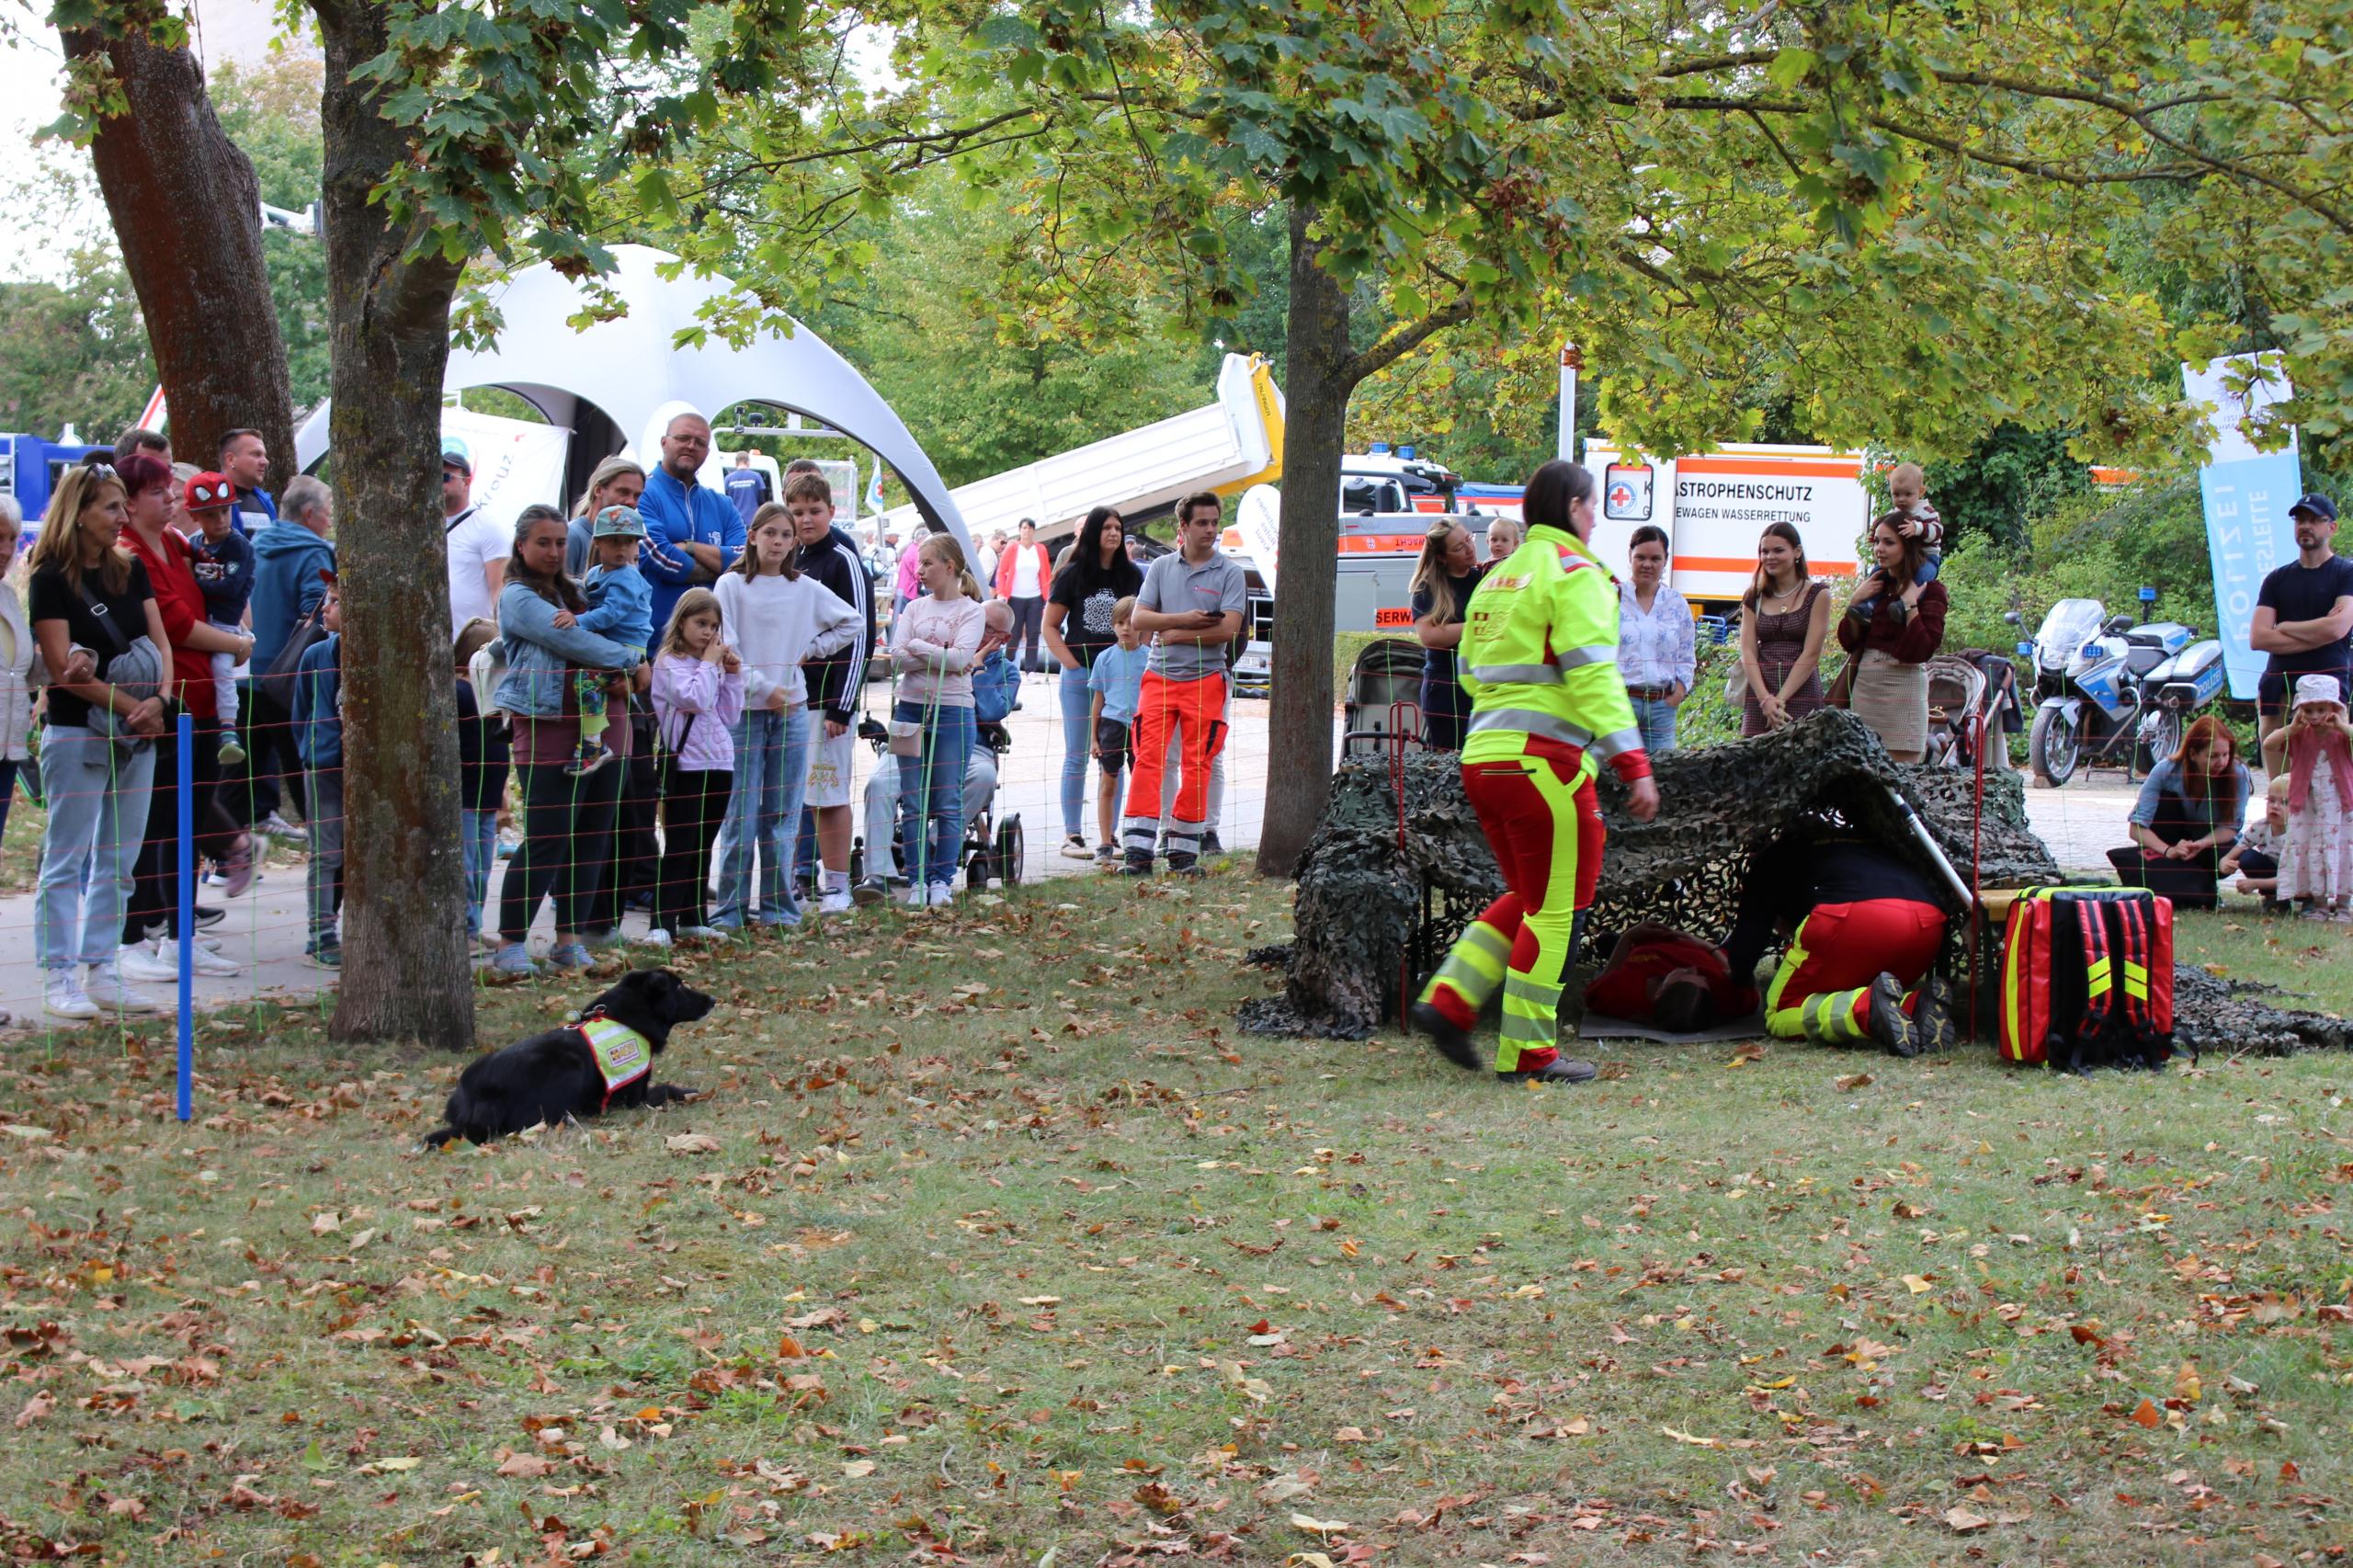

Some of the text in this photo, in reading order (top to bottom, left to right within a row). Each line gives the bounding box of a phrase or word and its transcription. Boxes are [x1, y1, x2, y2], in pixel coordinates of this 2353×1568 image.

[1722, 508, 1811, 522] WASSERRETTUNG
[1395, 538, 1425, 547] WACHT
[1376, 611, 1412, 624] SERW
